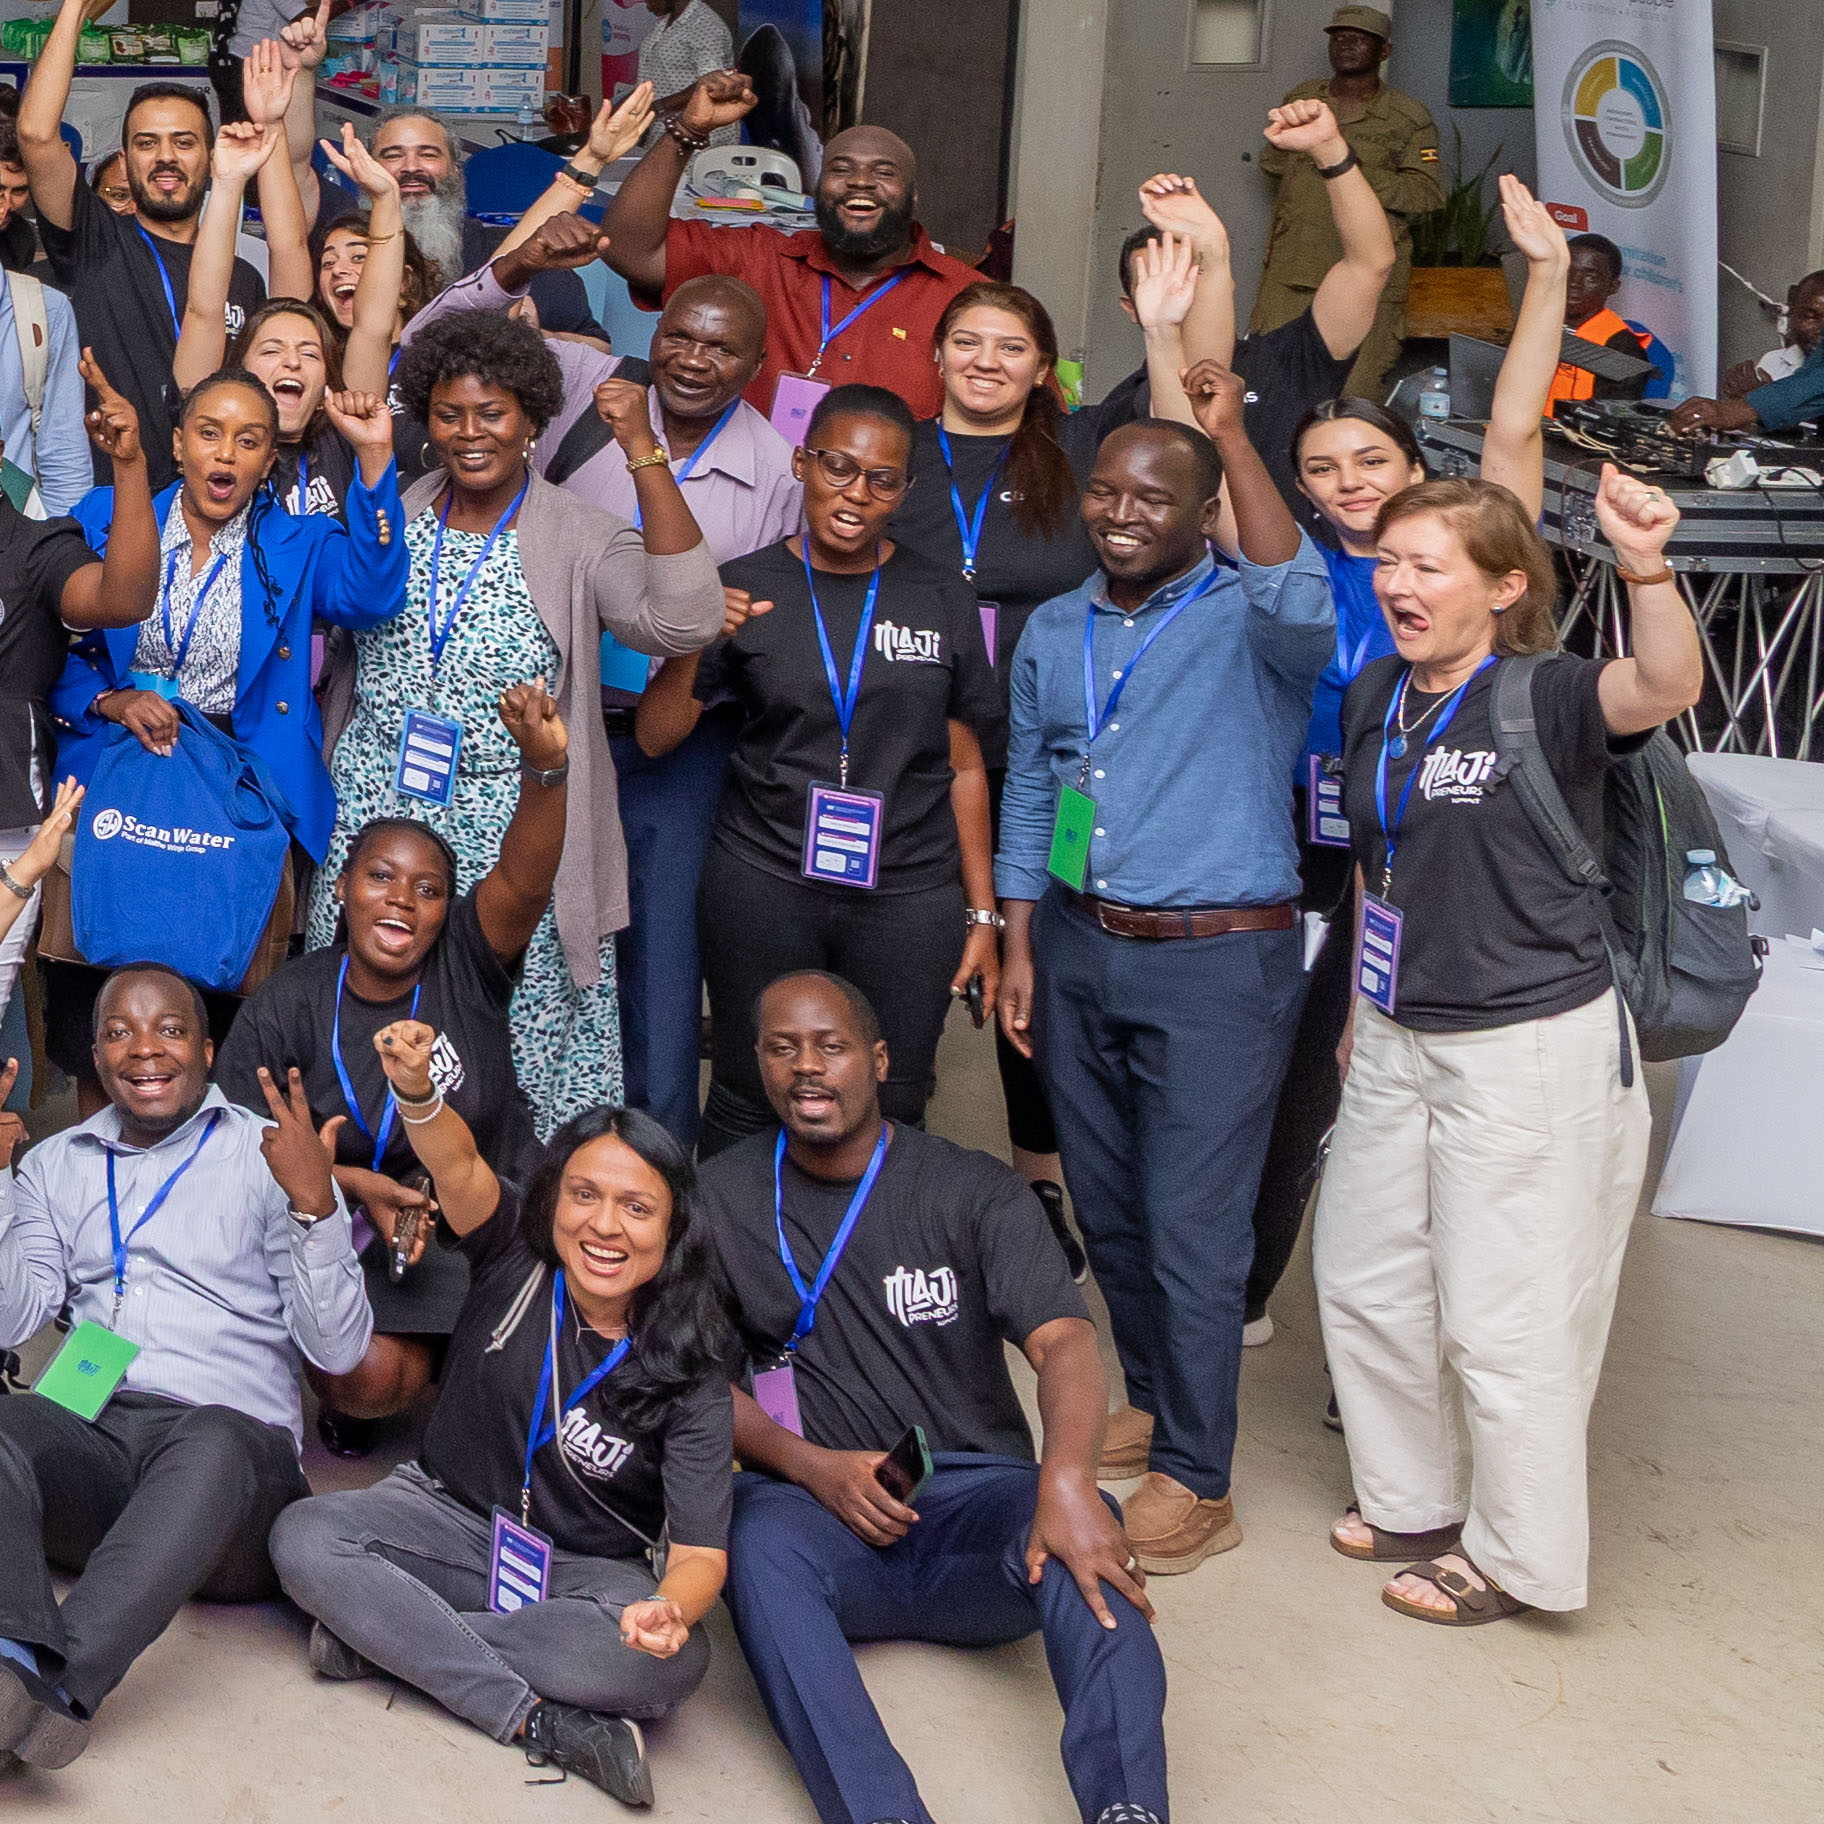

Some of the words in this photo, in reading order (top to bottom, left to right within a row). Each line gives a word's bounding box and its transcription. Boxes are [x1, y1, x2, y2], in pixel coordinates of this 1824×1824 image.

[1555, 210, 1578, 225] Goal
[1432, 785, 1484, 797] PRENEURS
[121, 831, 136, 842] Part
[185, 845, 207, 855] Group
[907, 1304, 959, 1324] PRENEURS
[562, 1444, 615, 1479] PRENEURS
